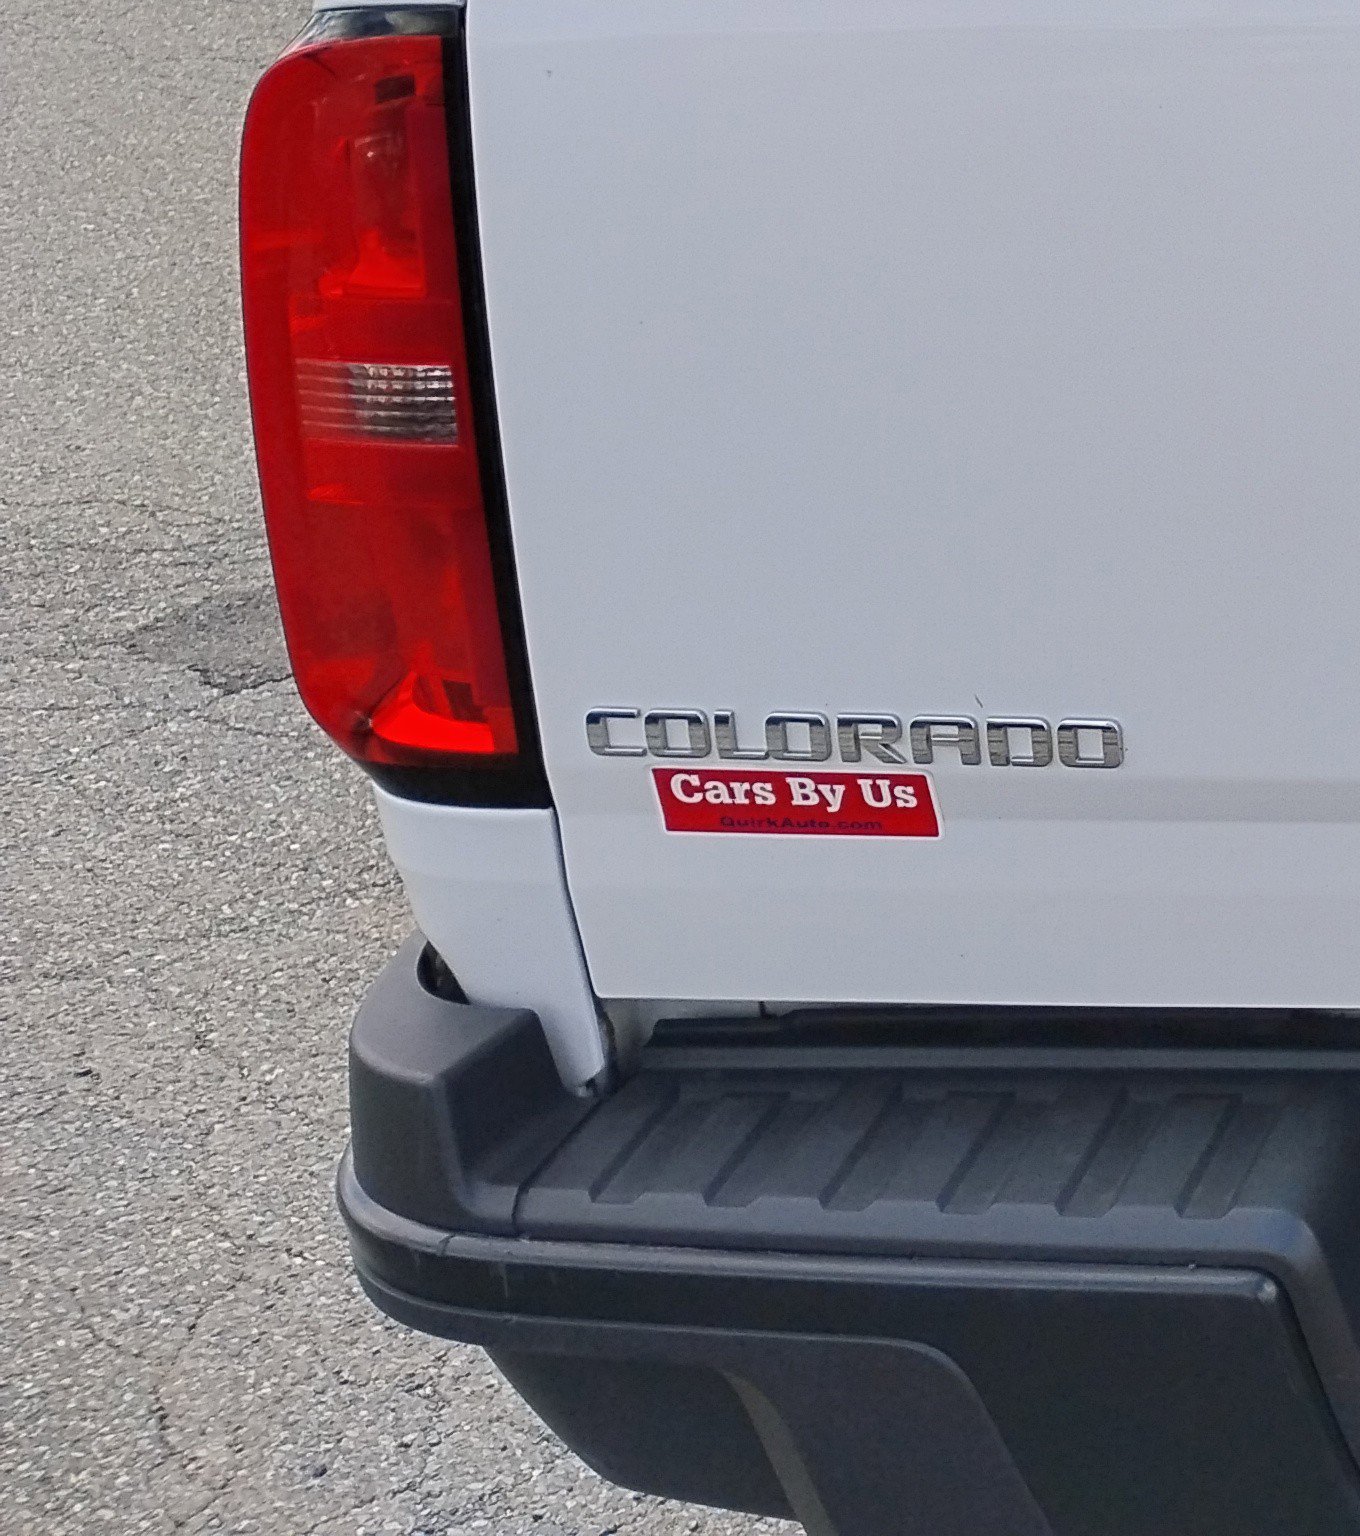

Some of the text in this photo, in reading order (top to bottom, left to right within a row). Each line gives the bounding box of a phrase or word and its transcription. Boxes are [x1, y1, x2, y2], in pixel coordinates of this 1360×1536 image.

[585, 707, 1125, 769] COLORADO
[670, 773, 918, 813] Cars By Us
